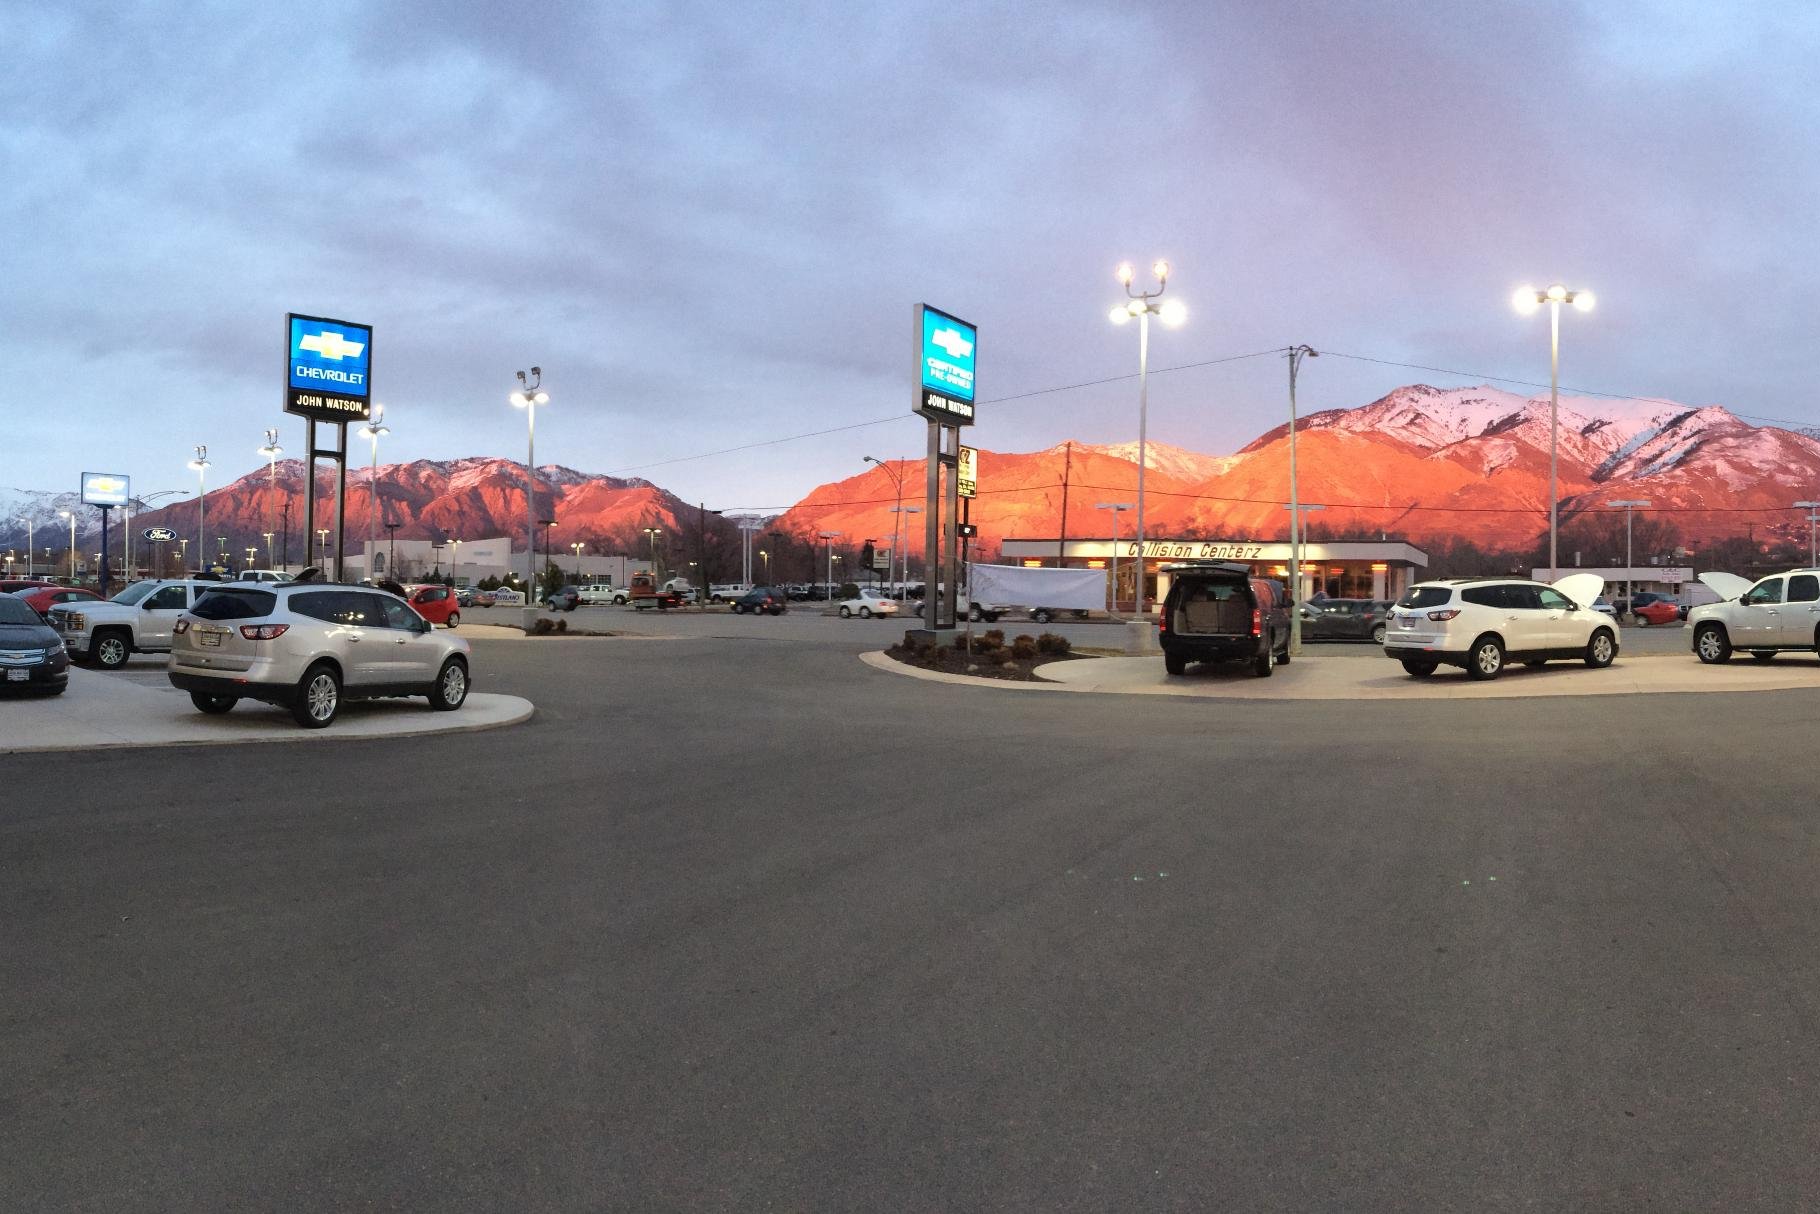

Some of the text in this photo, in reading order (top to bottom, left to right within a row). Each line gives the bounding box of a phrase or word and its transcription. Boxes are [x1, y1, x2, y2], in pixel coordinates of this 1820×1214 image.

[296, 365, 364, 385] CHEVROLET
[297, 395, 363, 412] JOHN WATSON
[928, 394, 973, 417] JOHN WATSON
[1200, 543, 1263, 559] Centerz
